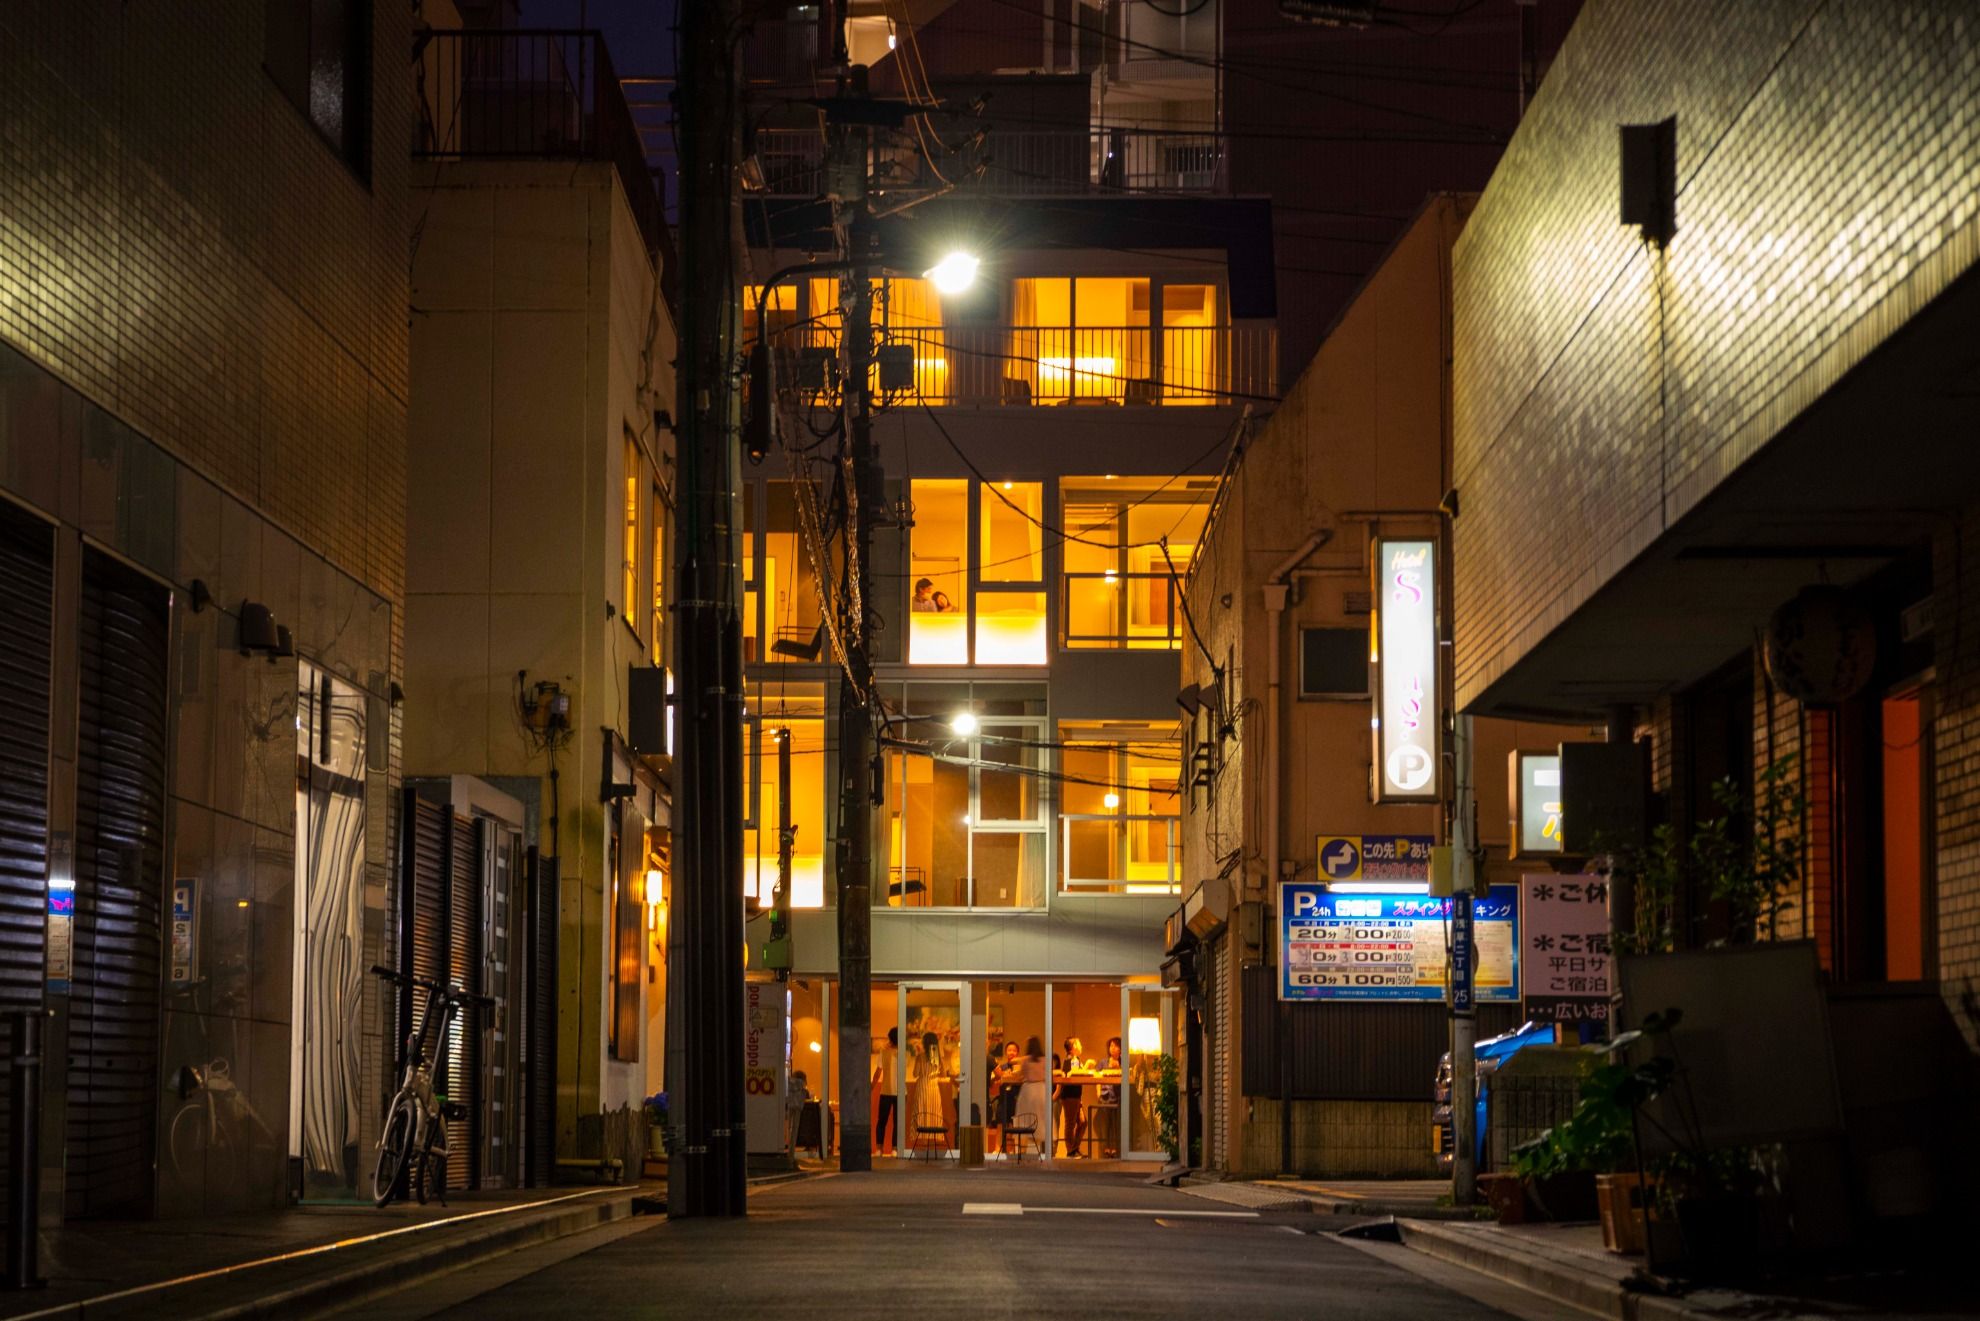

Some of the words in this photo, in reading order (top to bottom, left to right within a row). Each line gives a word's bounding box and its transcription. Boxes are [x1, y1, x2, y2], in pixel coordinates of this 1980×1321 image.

[1398, 755, 1425, 785] P
[1312, 906, 1331, 916] 24h
[1298, 929, 1337, 939] 20分
[1298, 975, 1338, 985] 60分
[1550, 977, 1608, 992] ご宿泊
[1454, 990, 1468, 1002] 25
